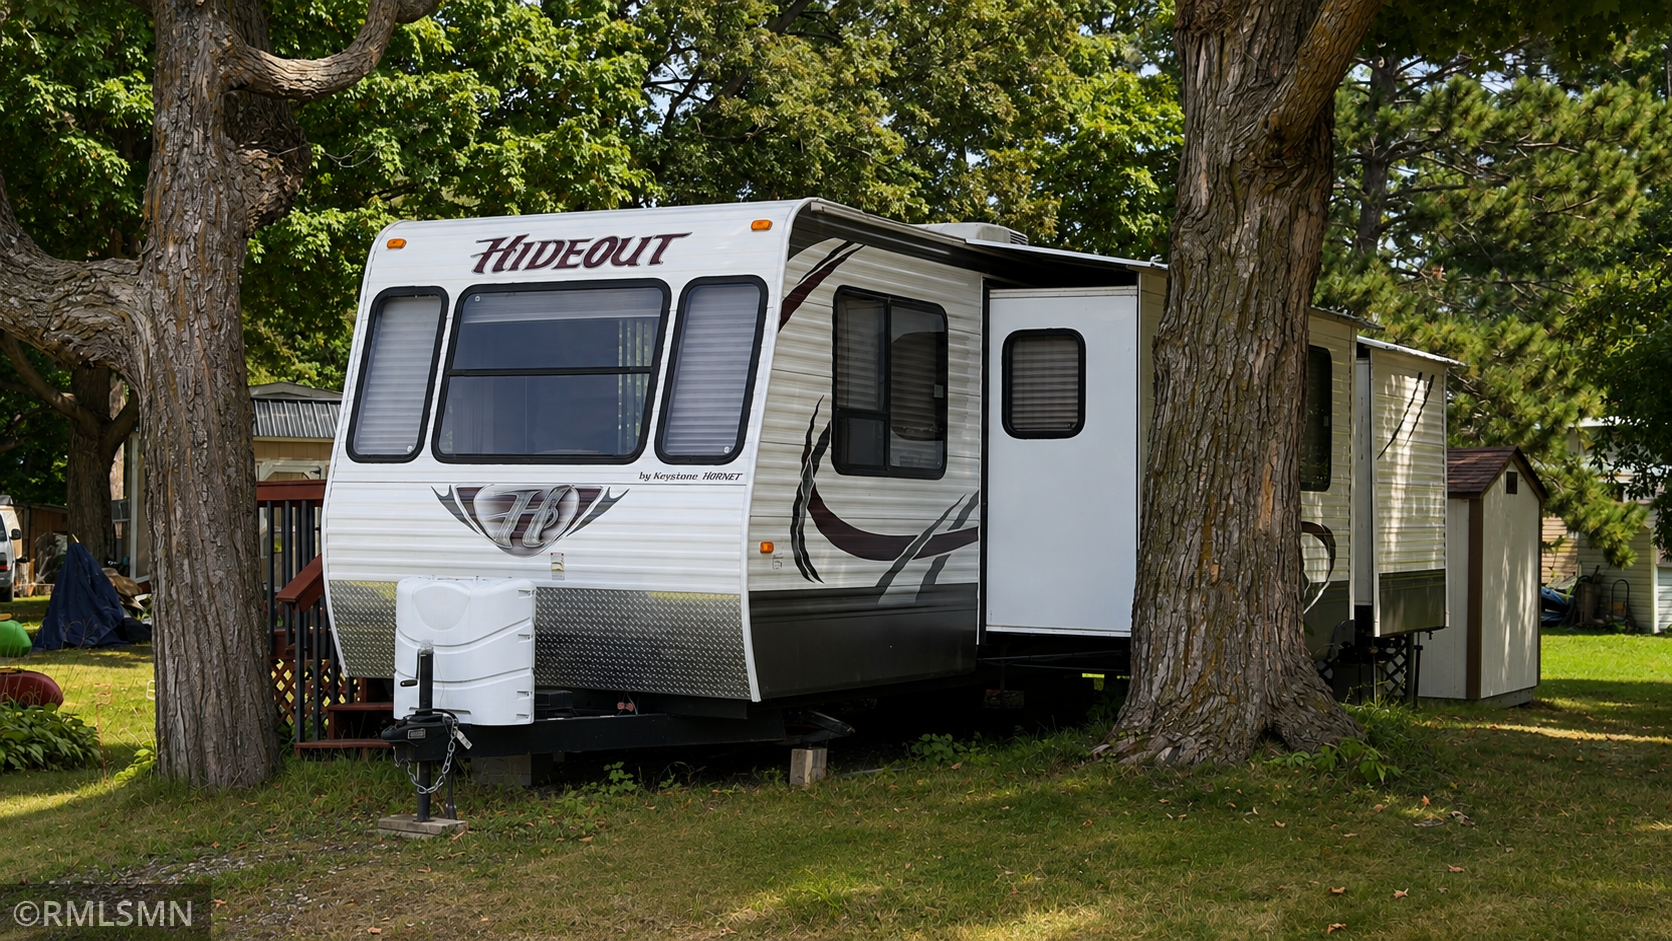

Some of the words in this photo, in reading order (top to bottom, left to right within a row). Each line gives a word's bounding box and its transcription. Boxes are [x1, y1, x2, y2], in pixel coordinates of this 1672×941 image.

[470, 231, 693, 274] HIDEOUT
[638, 471, 652, 482] by
[653, 471, 699, 482] Keystone
[701, 471, 744, 481] HORNET
